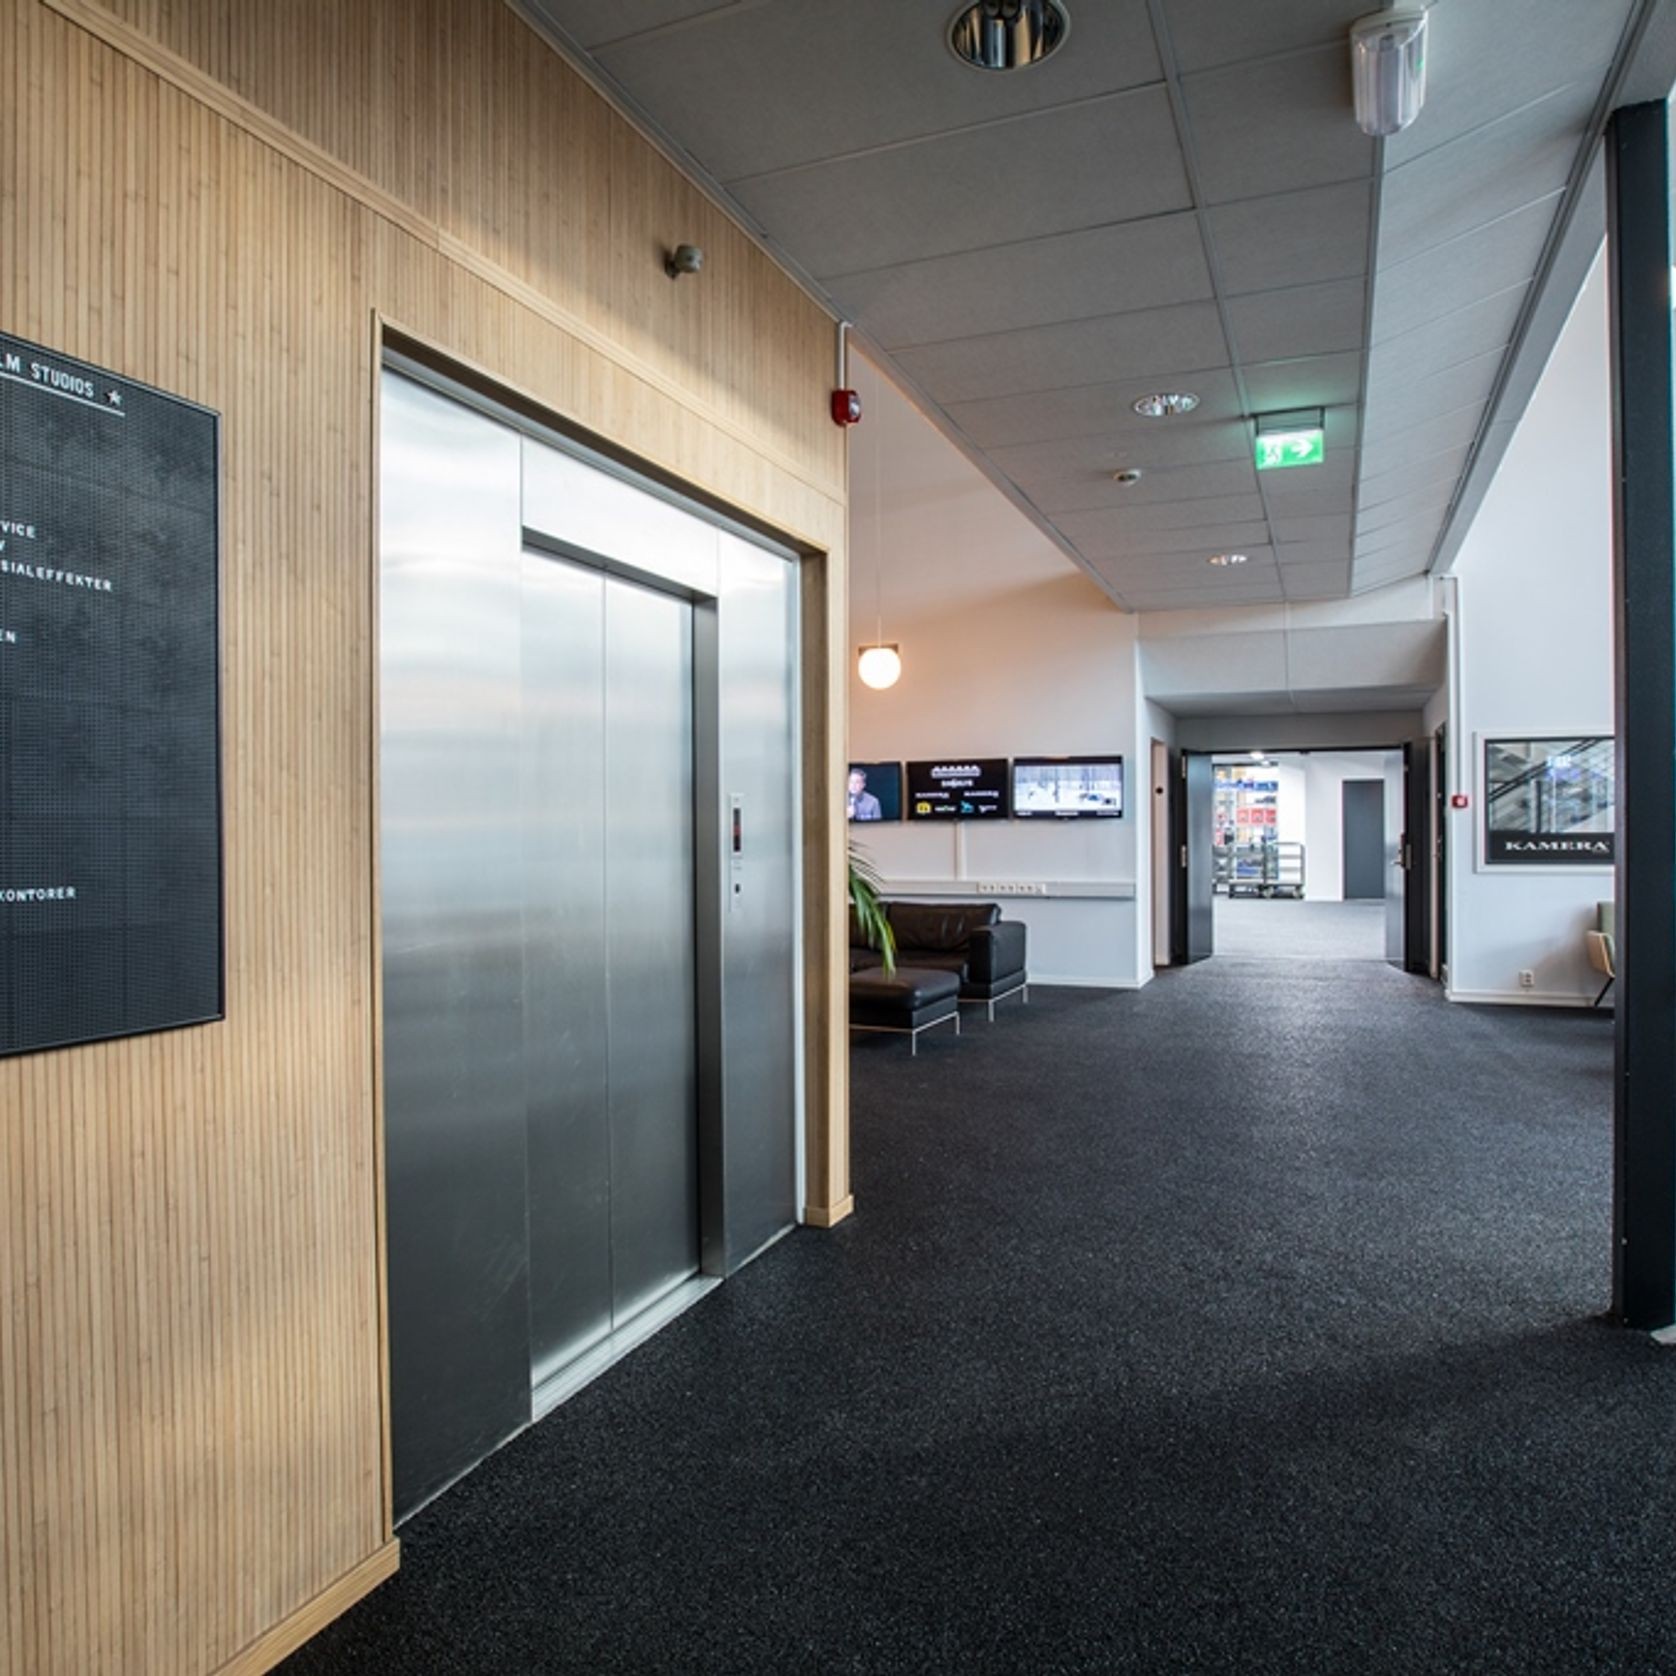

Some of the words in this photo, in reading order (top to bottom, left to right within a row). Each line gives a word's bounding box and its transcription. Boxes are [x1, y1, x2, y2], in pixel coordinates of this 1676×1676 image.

[0, 352, 20, 373] M
[31, 362, 94, 399] STUDIOS
[0, 520, 36, 539] VICE
[1, 559, 112, 592] SIALEFFEKTER
[1505, 841, 1610, 853] KAMERA
